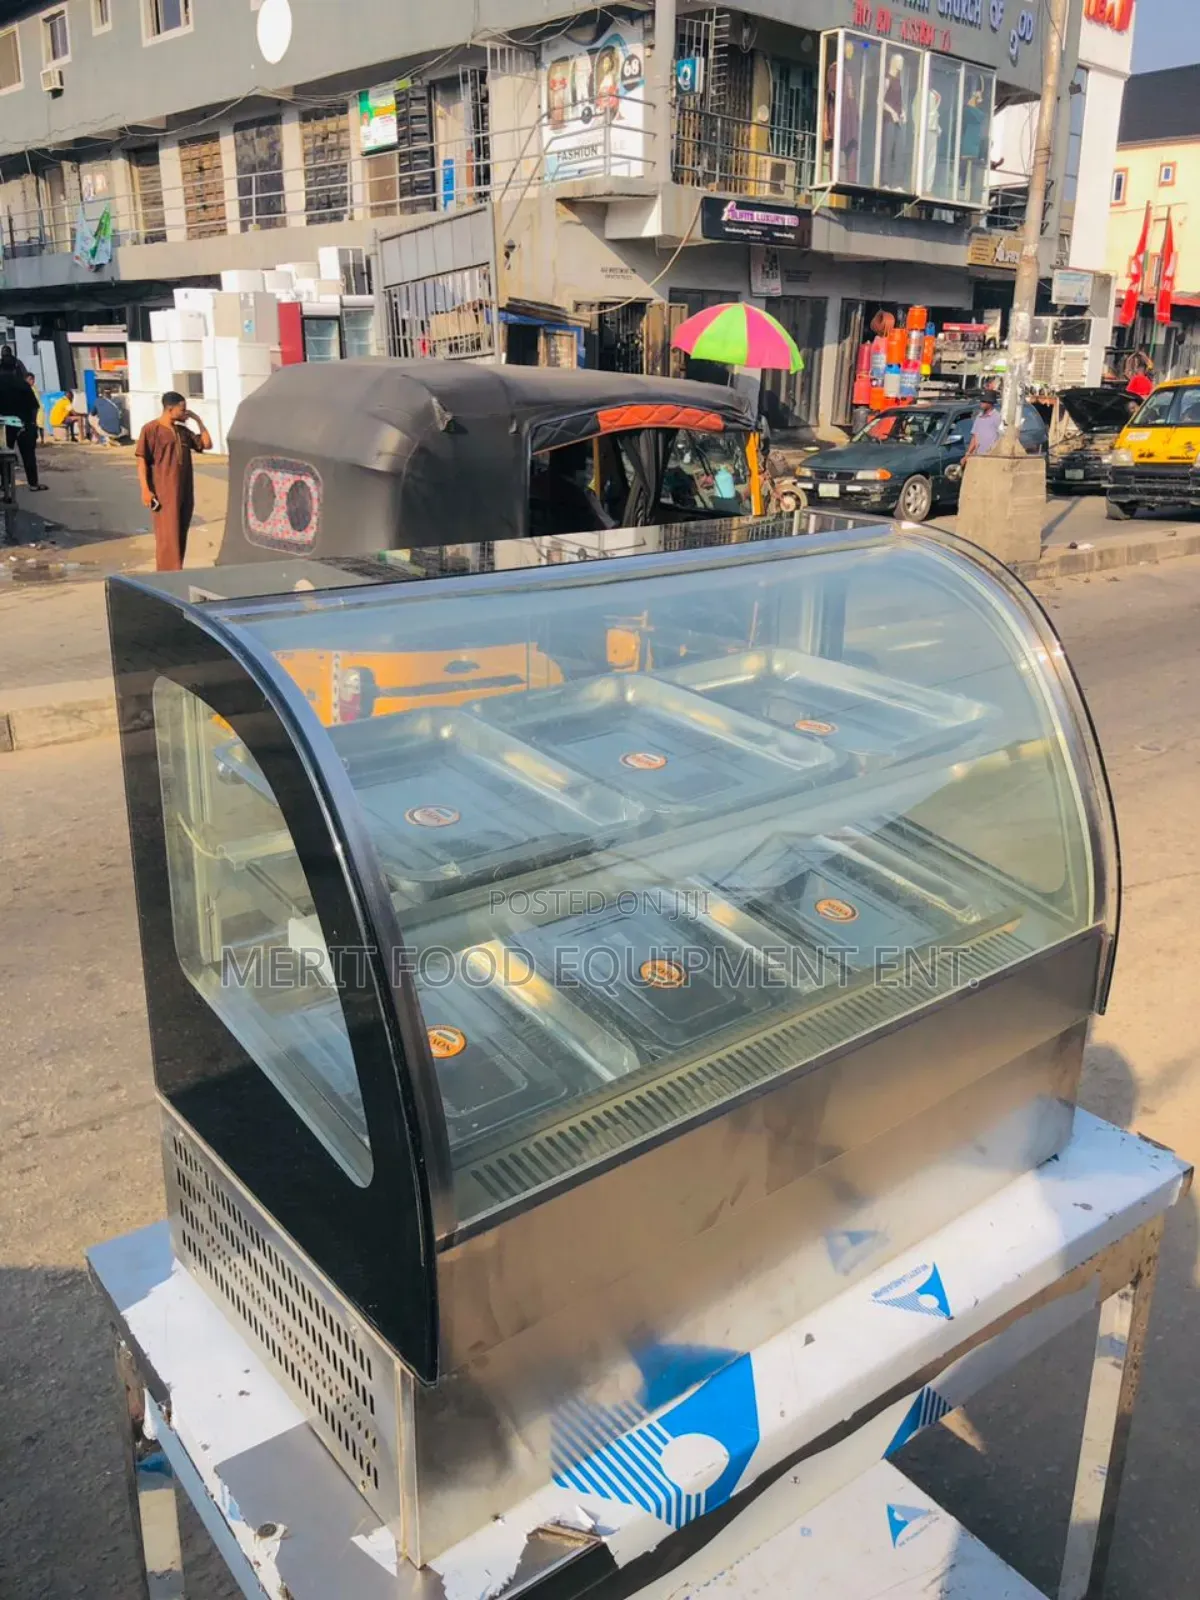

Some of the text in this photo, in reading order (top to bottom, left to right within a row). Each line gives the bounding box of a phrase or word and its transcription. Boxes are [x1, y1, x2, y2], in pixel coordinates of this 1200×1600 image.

[937, 0, 982, 29] CHURCH
[989, 0, 1005, 31] OF
[556, 146, 598, 162] FASHION
[755, 211, 785, 226] LUXURY
